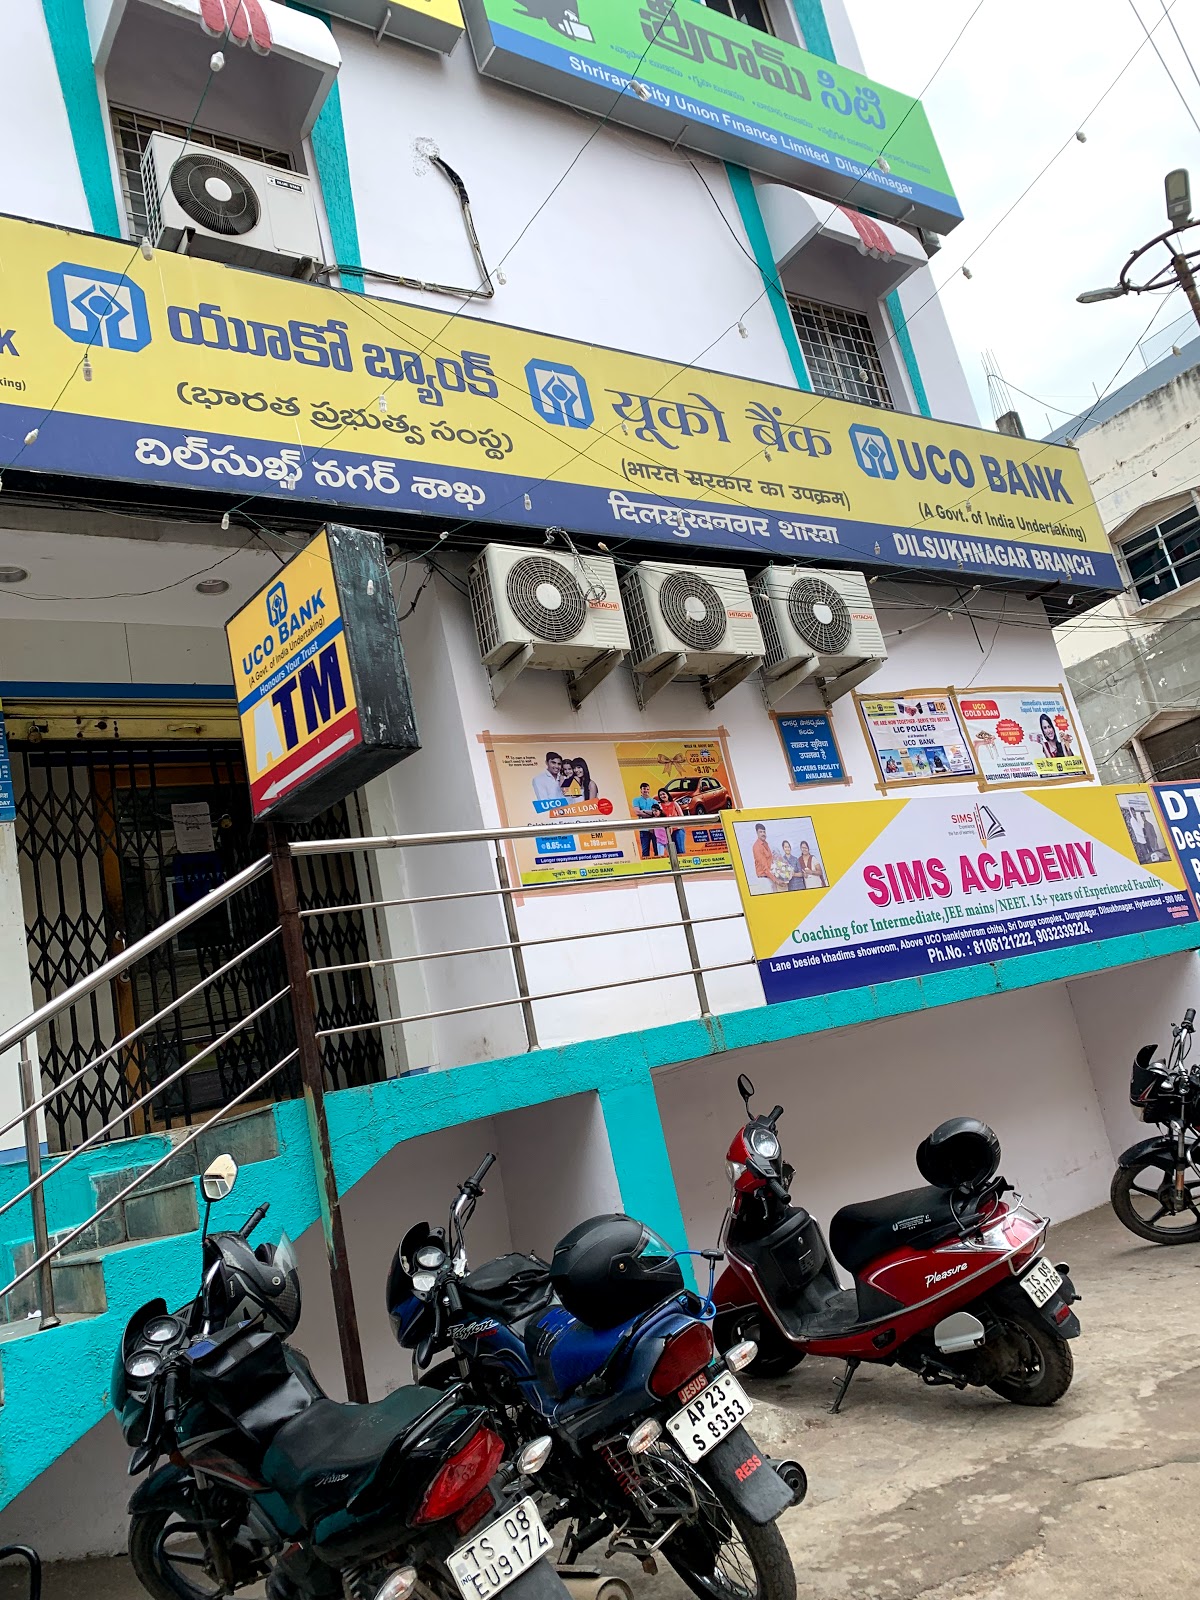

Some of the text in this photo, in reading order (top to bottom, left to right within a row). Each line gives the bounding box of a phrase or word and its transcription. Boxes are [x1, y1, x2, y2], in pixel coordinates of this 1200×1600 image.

[568, 55, 632, 91] Shriram
[639, 82, 671, 107] City
[674, 95, 720, 123] Union
[721, 113, 778, 145] Finance
[780, 136, 830, 164] Limited
[834, 157, 913, 195] Dilsukhnagar
[817, 68, 886, 130] సిటీ
[167, 303, 498, 407] యూకో బ్యాంక్
[176, 381, 301, 417] (భారత
[309, 400, 426, 445] ప్రభుత్వ
[604, 388, 832, 458] यूको बैंक
[314, 458, 401, 496] నగర్
[410, 474, 487, 512] శాఖ
[621, 458, 852, 512] (भारत सरकार का उपक्रम)
[897, 439, 1074, 506] UCO BANK
[607, 491, 840, 544] दिलसुखनगर शाखा
[919, 501, 1087, 543] (A Govt. of India Undertaking)
[893, 532, 1097, 577] DILSUKHNAGAR BRANCH
[242, 587, 326, 675] UCO BANK
[727, 610, 753, 619] HITACHI
[852, 613, 874, 621] HITACHI
[269, 659, 276, 669] of
[275, 647, 289, 664] India
[288, 614, 325, 651] Undertaking)
[259, 640, 319, 696] Honours Your Trust
[253, 642, 347, 774] ATM
[906, 724, 936, 732] POLICES
[964, 709, 983, 717] GOLD
[817, 763, 840, 771] FACILITY
[540, 799, 562, 810] UCO
[951, 813, 973, 824] SIMS
[1170, 826, 1200, 851] Des
[863, 841, 1098, 907] SIMS ACADEMY
[770, 961, 791, 973] Lane
[792, 956, 821, 970] beside
[822, 950, 856, 965] khadims
[857, 943, 900, 961] showroom,
[900, 939, 924, 951] Above
[924, 934, 942, 946] UCO
[943, 927, 987, 943] bank(shriram
[987, 924, 1007, 937] chits),
[1008, 920, 1017, 931] Sri
[1017, 917, 1037, 930] Durga
[1037, 912, 1064, 927] complex,
[1064, 905, 1099, 922] Durganagar,
[1099, 900, 1135, 917] Dilsukhnagar,
[1134, 896, 1162, 910] Hyderabad
[791, 923, 851, 944] Coaching
[850, 920, 869, 941] for
[964, 894, 1030, 916] mains/NEET.
[1030, 892, 1048, 907] 15+
[1049, 889, 1072, 906] years
[1073, 886, 1083, 901] of
[1083, 879, 1133, 901] Experienced
[1134, 876, 1164, 891] Faculty.
[973, 932, 1036, 955] 8106121222,
[1036, 923, 1093, 943] 9032339224.
[924, 1262, 968, 1288] Pleasure
[1026, 1274, 1041, 1289] TS
[448, 1319, 499, 1340] Passion
[681, 1374, 708, 1404] JESUS
[686, 1385, 726, 1427] AP 23
[692, 1399, 745, 1451] S 8353
[734, 1454, 762, 1483] RESS
[465, 1509, 530, 1569] TS 08
[471, 1526, 548, 1599] EU9174
